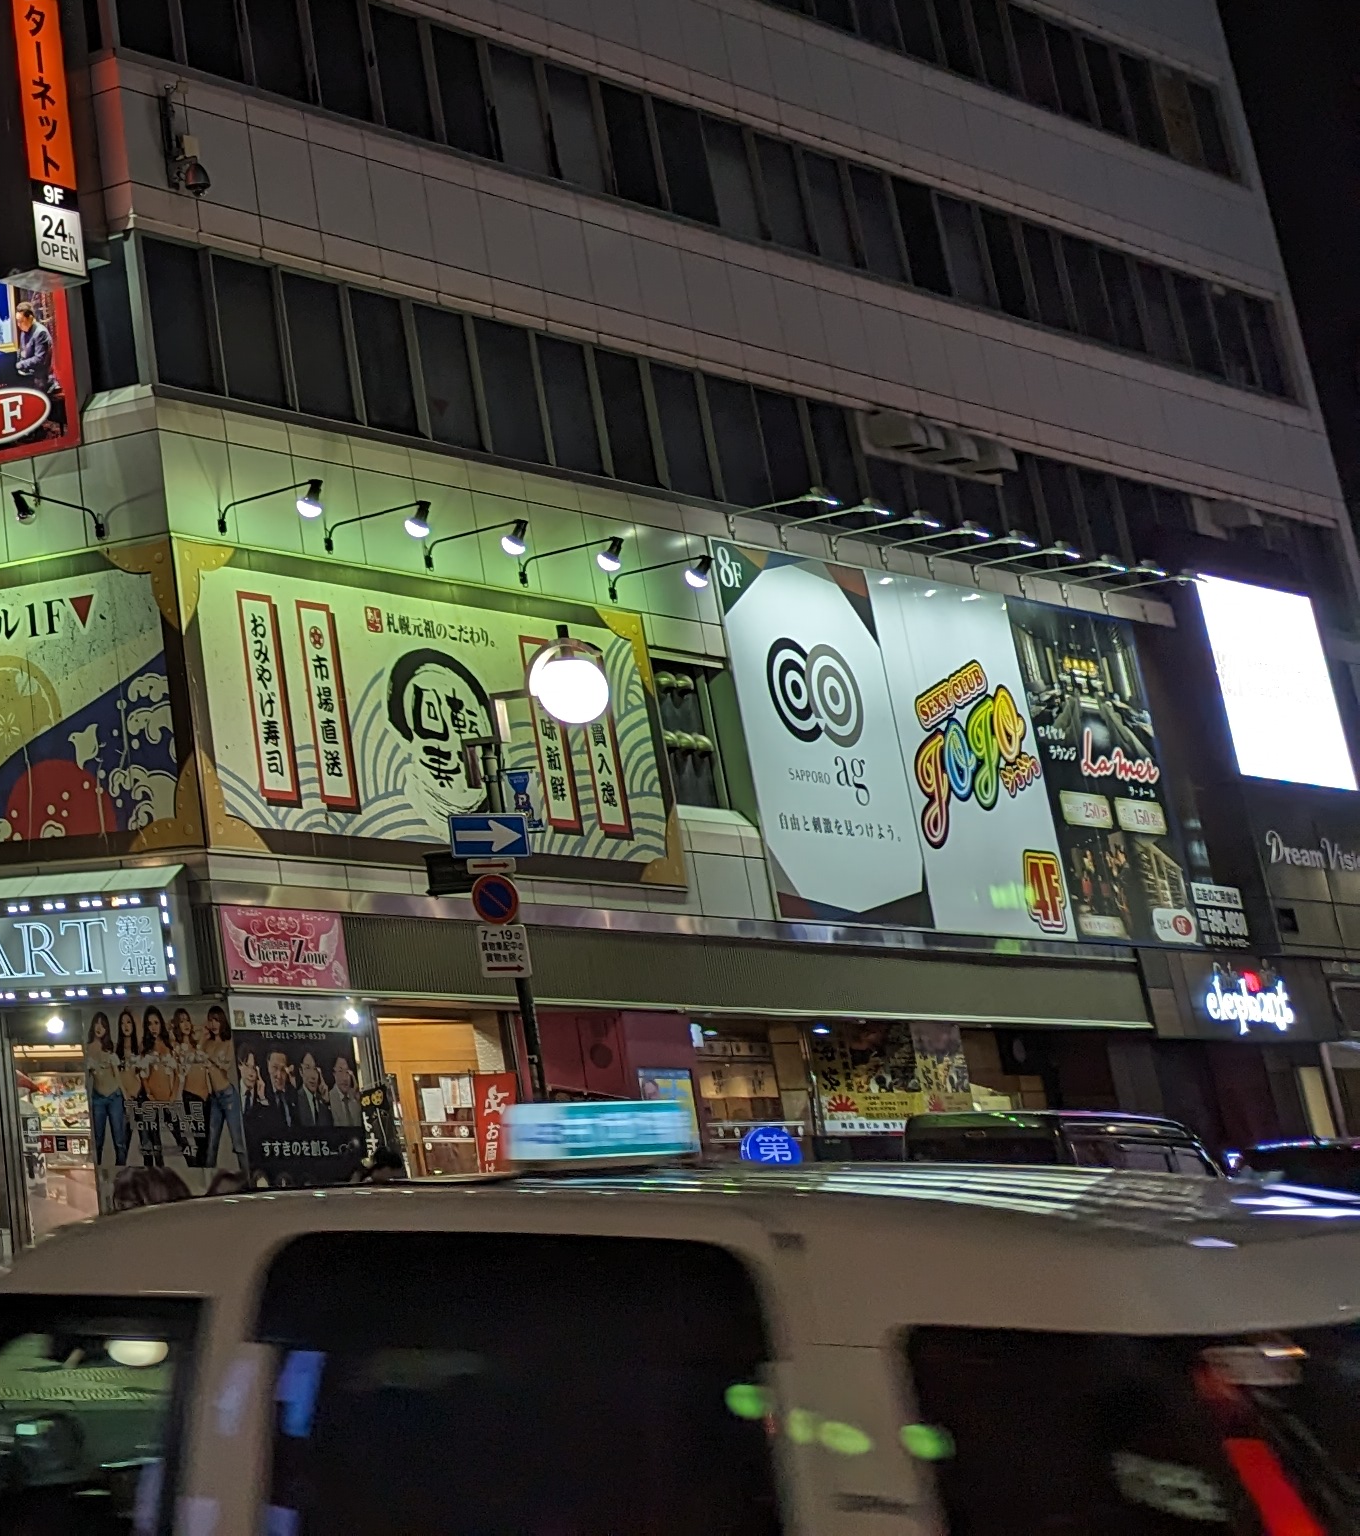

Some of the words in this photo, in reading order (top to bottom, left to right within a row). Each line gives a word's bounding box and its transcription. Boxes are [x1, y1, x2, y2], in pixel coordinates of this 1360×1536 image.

[42, 184, 65, 205] 9F
[40, 213, 77, 246] 24h
[40, 239, 79, 264] OPEN
[717, 545, 744, 589] 8F
[385, 612, 497, 648] 札幌元祖のこだわり。
[248, 611, 286, 778] おみやげ寿司
[311, 653, 344, 779] 市場直送
[918, 680, 952, 724] SEXY
[949, 667, 985, 707] CLUB
[412, 682, 481, 742] 回転
[1037, 724, 1066, 740] ロイヤル
[538, 710, 568, 803] 味新鮮
[1048, 744, 1077, 761] ラウンジ
[787, 766, 832, 786] SAPPORO
[834, 754, 872, 807] ag
[778, 811, 902, 843] 自由と刺激を見つけよう。
[1265, 830, 1323, 869] Dream
[1023, 850, 1068, 933] 4F
[115, 914, 153, 938] 第2
[118, 935, 155, 956] Gビル
[243, 935, 290, 968] Cherry
[291, 938, 329, 966] Zone
[121, 953, 158, 977] 4階
[231, 969, 247, 982] 2F
[248, 1013, 279, 1027] 株式会社
[280, 1013, 346, 1028] ホームエージェン
[179, 1120, 206, 1133] BAR
